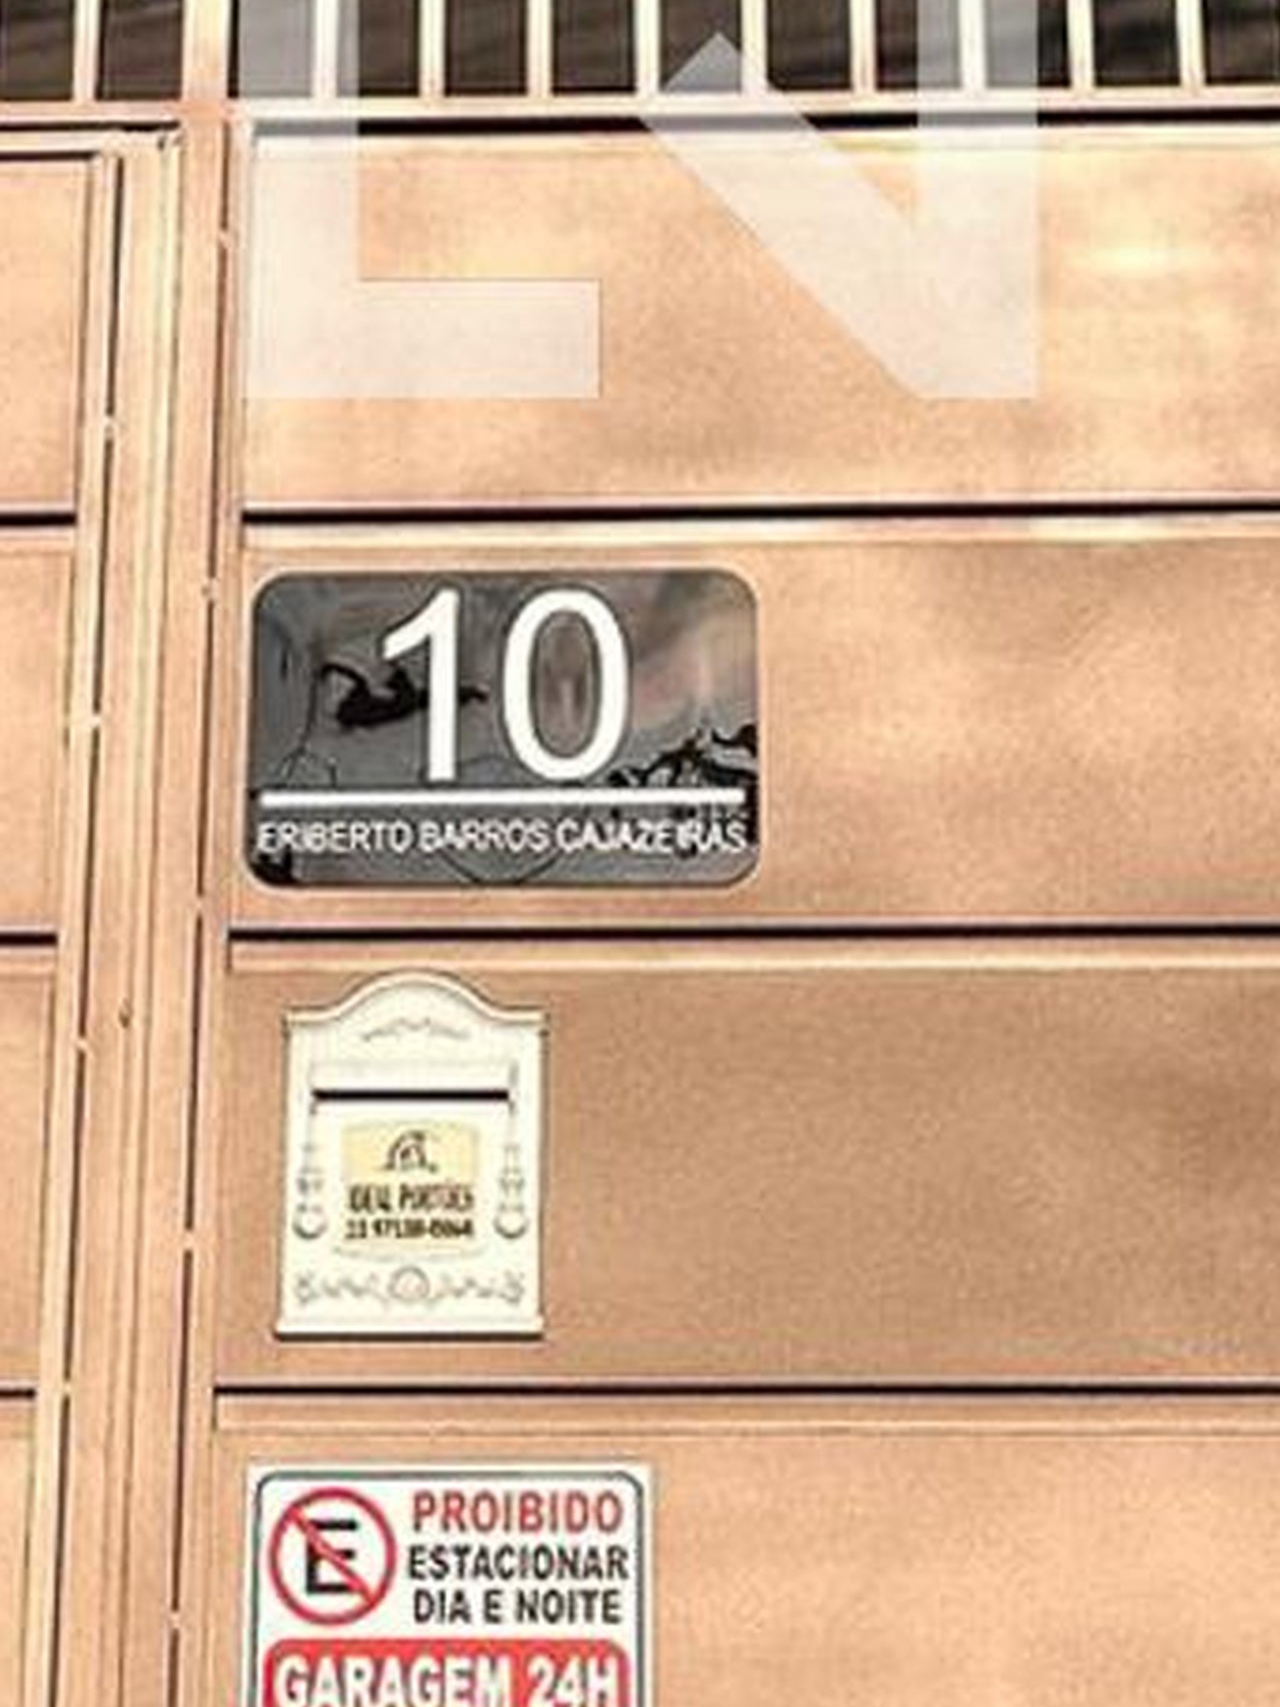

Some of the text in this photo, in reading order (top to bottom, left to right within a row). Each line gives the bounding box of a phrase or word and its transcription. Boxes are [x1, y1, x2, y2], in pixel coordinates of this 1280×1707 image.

[381, 587, 631, 783] 10
[257, 817, 747, 854] ERIBERTO BARROS CAJAZEIRAS
[411, 1489, 624, 1535] PROIBIDO
[407, 1543, 631, 1582] ESTACIONAR
[413, 1589, 623, 1625] DIA E NOITE
